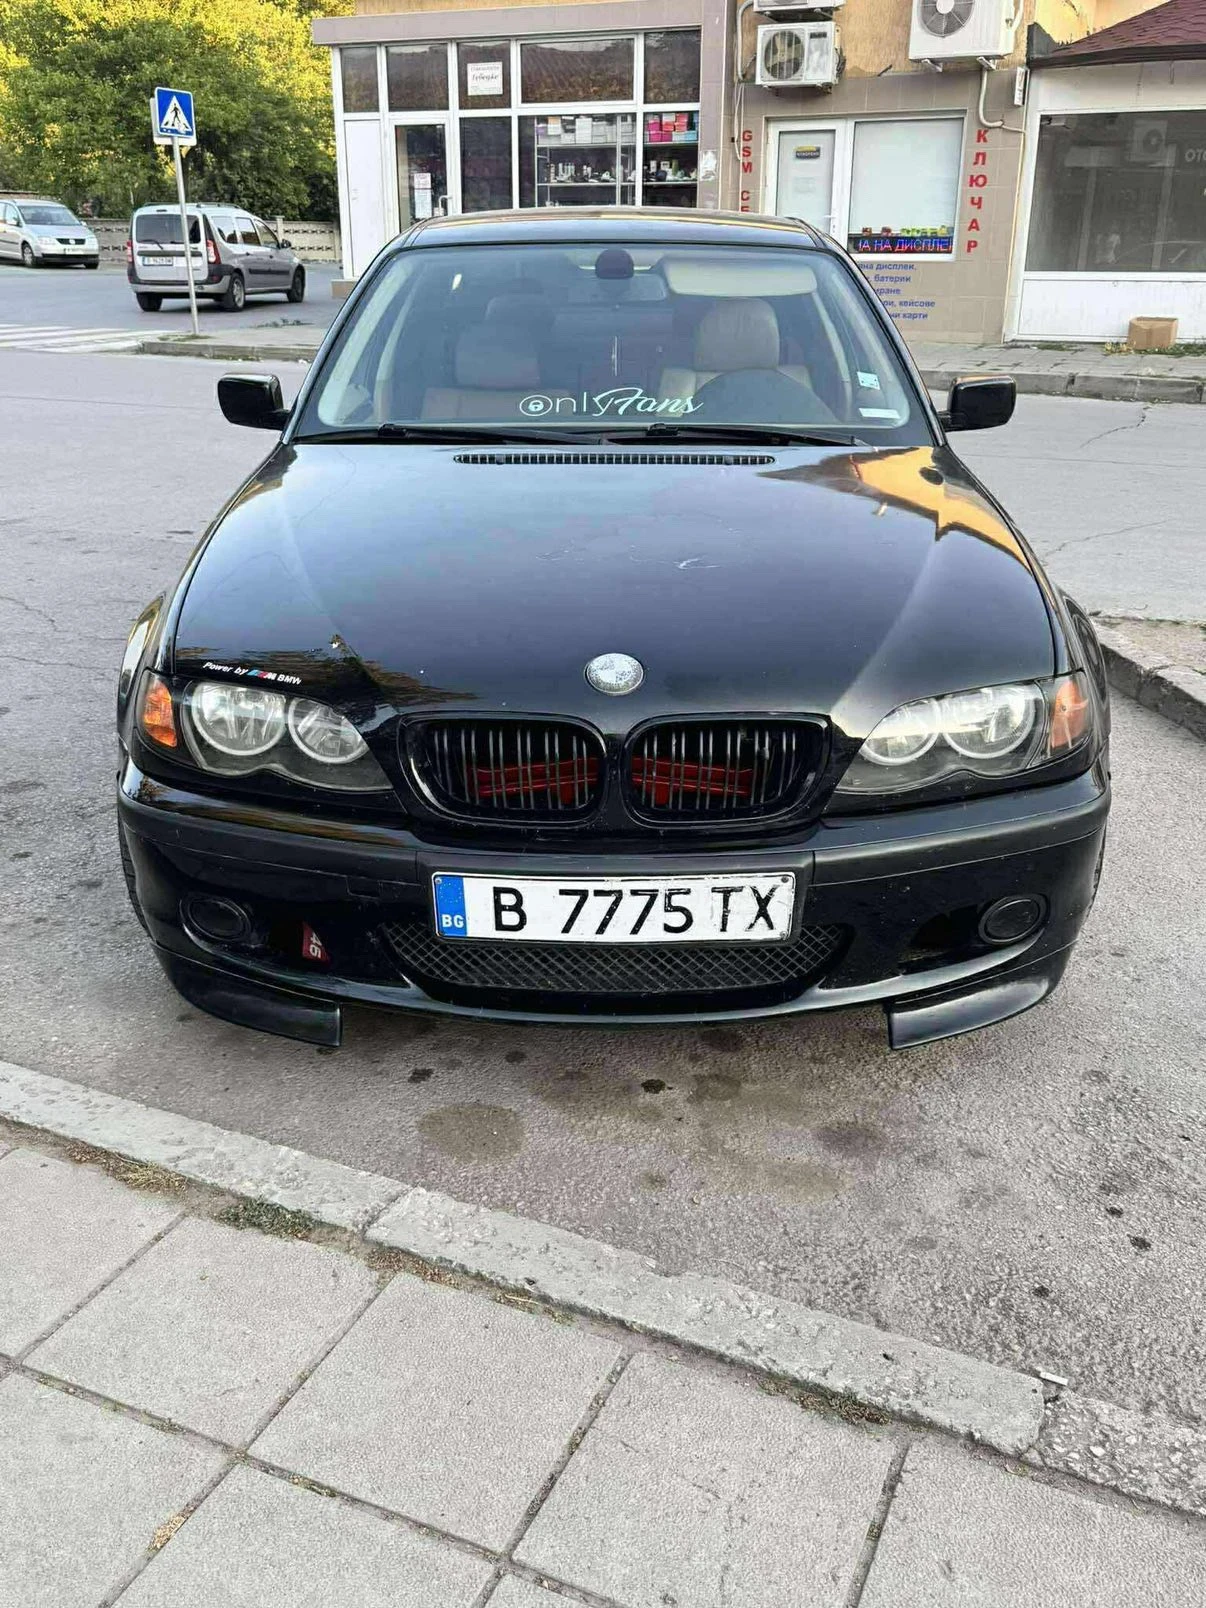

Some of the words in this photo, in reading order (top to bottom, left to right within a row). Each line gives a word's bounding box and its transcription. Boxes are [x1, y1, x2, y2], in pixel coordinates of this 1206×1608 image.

[742, 130, 752, 173] GSM
[966, 129, 988, 253] КЛЮЧАР
[874, 239, 892, 252] НА
[519, 387, 704, 417] OnlyFans
[203, 662, 232, 673] Power
[234, 666, 249, 676] by
[277, 674, 301, 685] BMW
[441, 914, 464, 929] BG
[493, 886, 527, 933] B
[558, 888, 694, 936] 7775
[711, 885, 781, 933] TX
